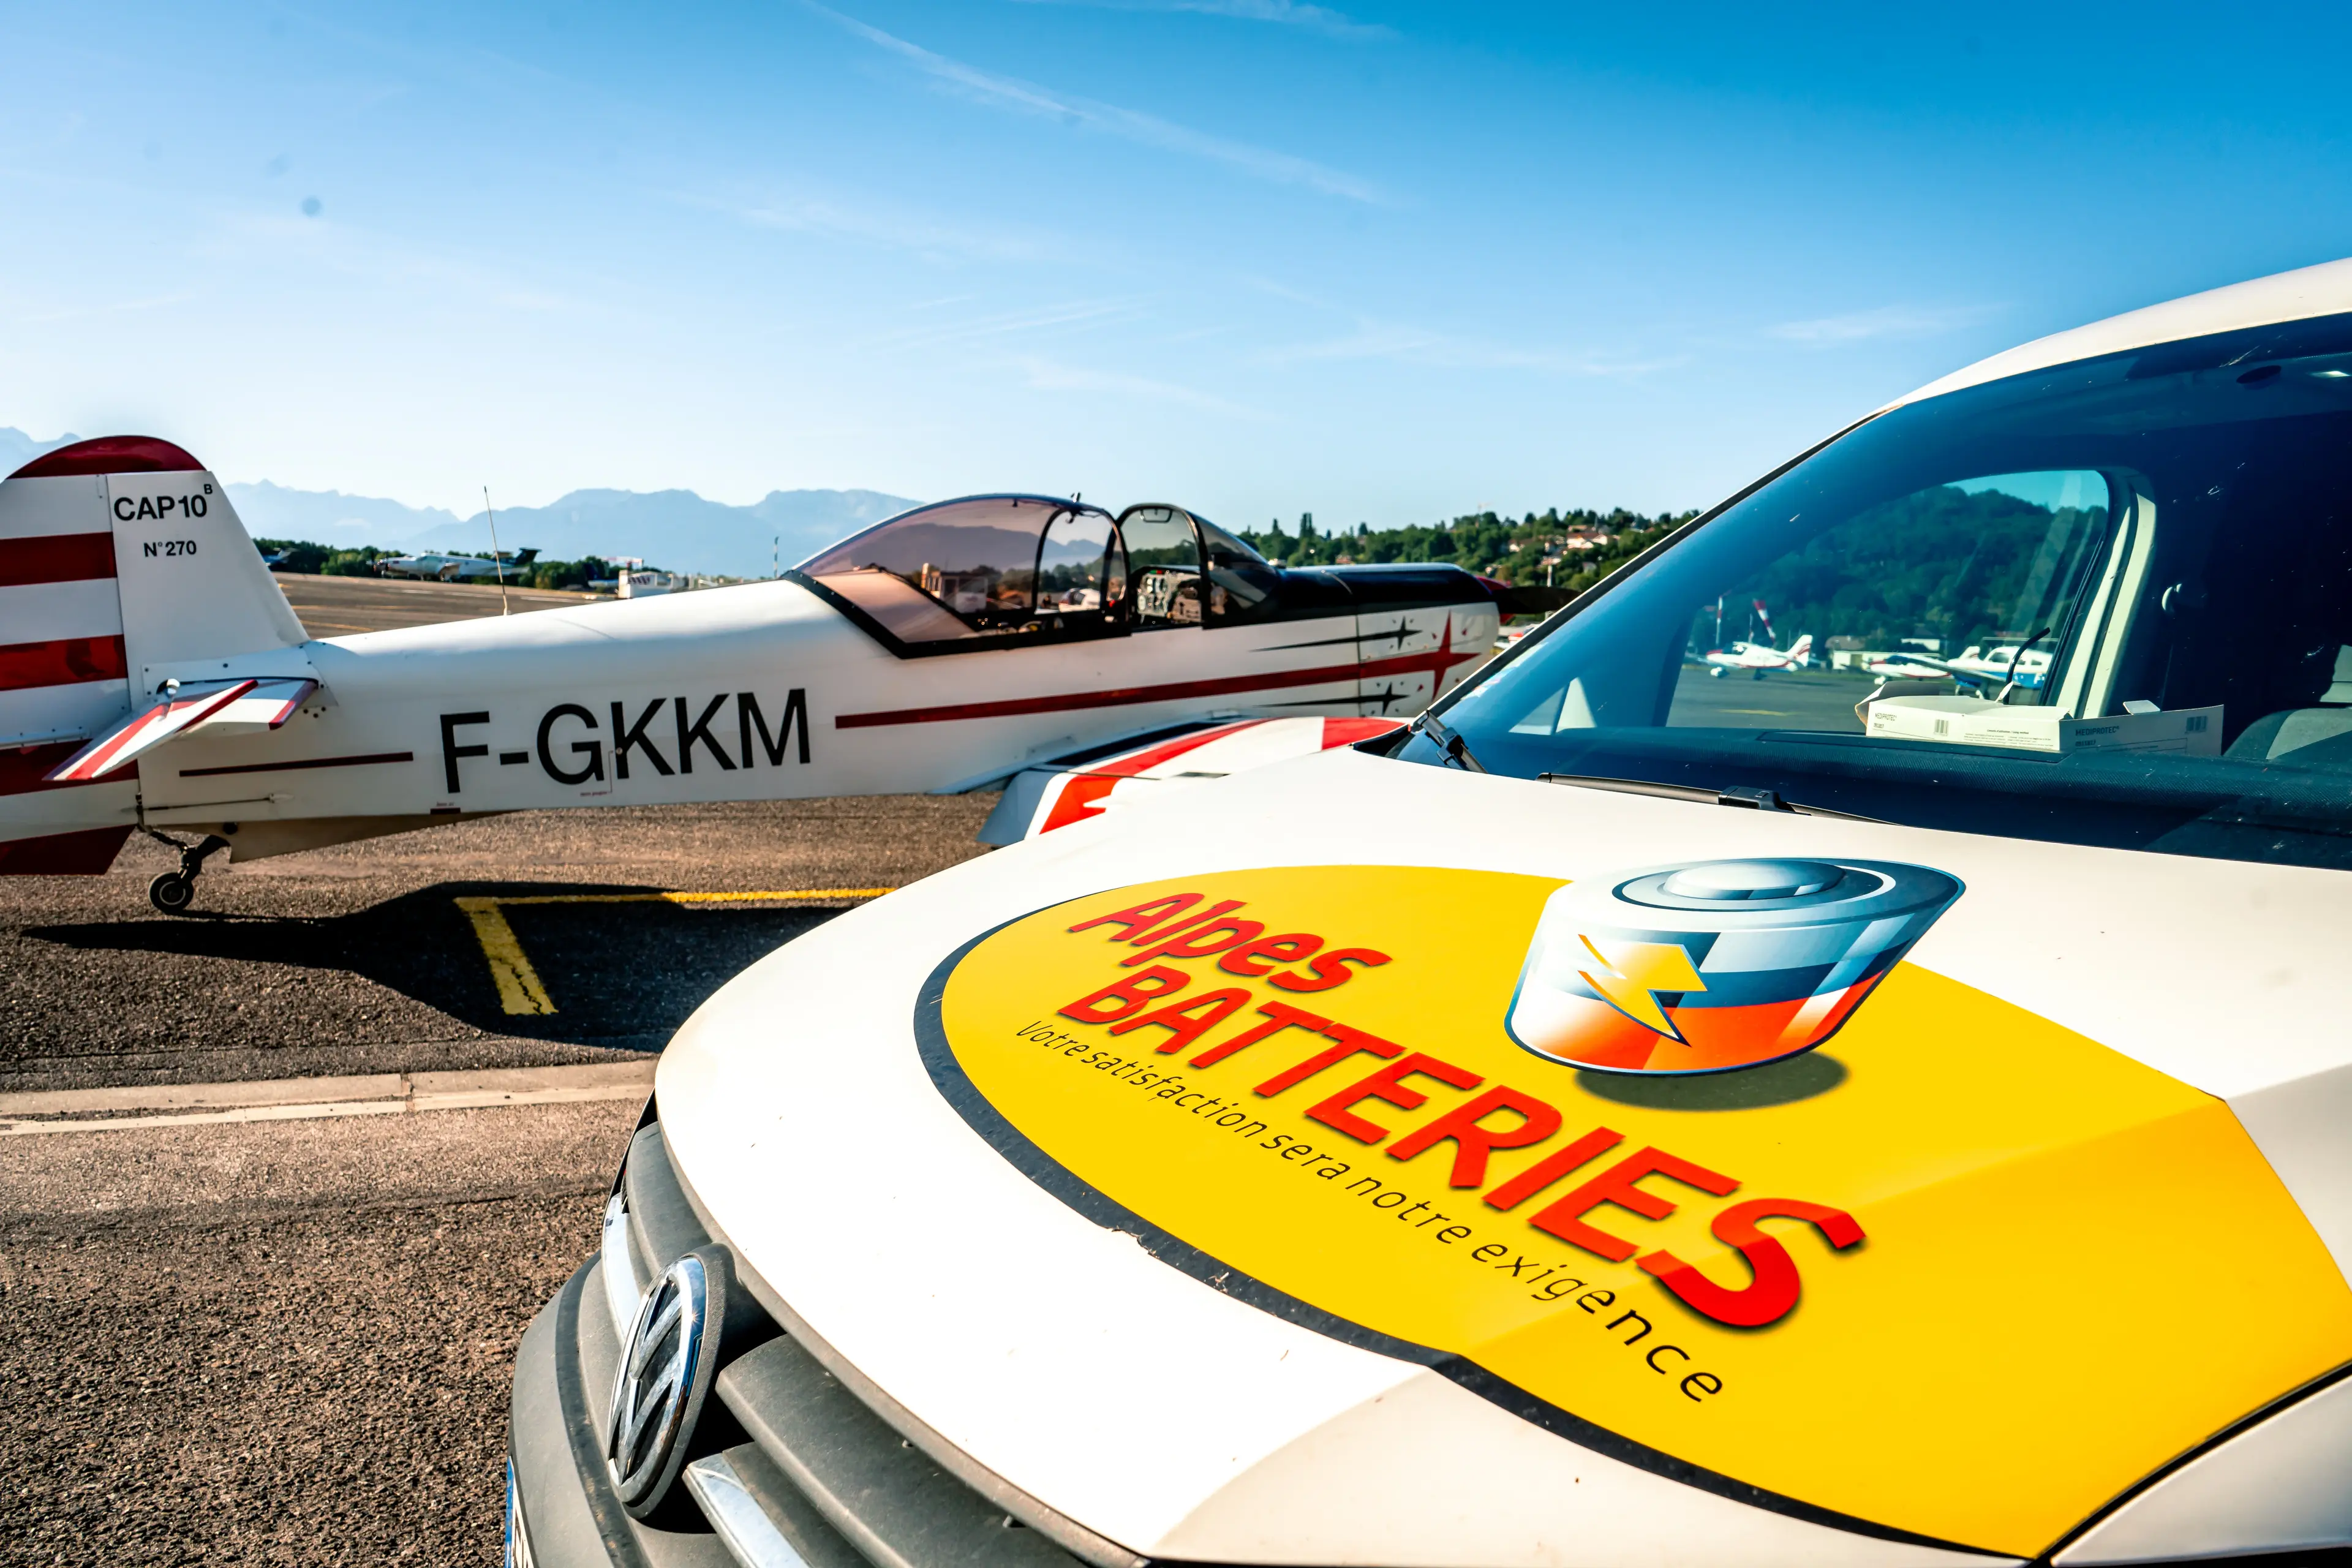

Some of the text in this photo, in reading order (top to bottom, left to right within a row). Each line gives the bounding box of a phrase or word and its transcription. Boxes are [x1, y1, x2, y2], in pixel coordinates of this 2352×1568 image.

[439, 687, 811, 794] F-GKKM
[1068, 892, 1393, 992] Alpes
[1016, 1020, 1724, 1403] Votre satisfaction sera notre exigence
[1057, 964, 1867, 1327] BATTERIES
